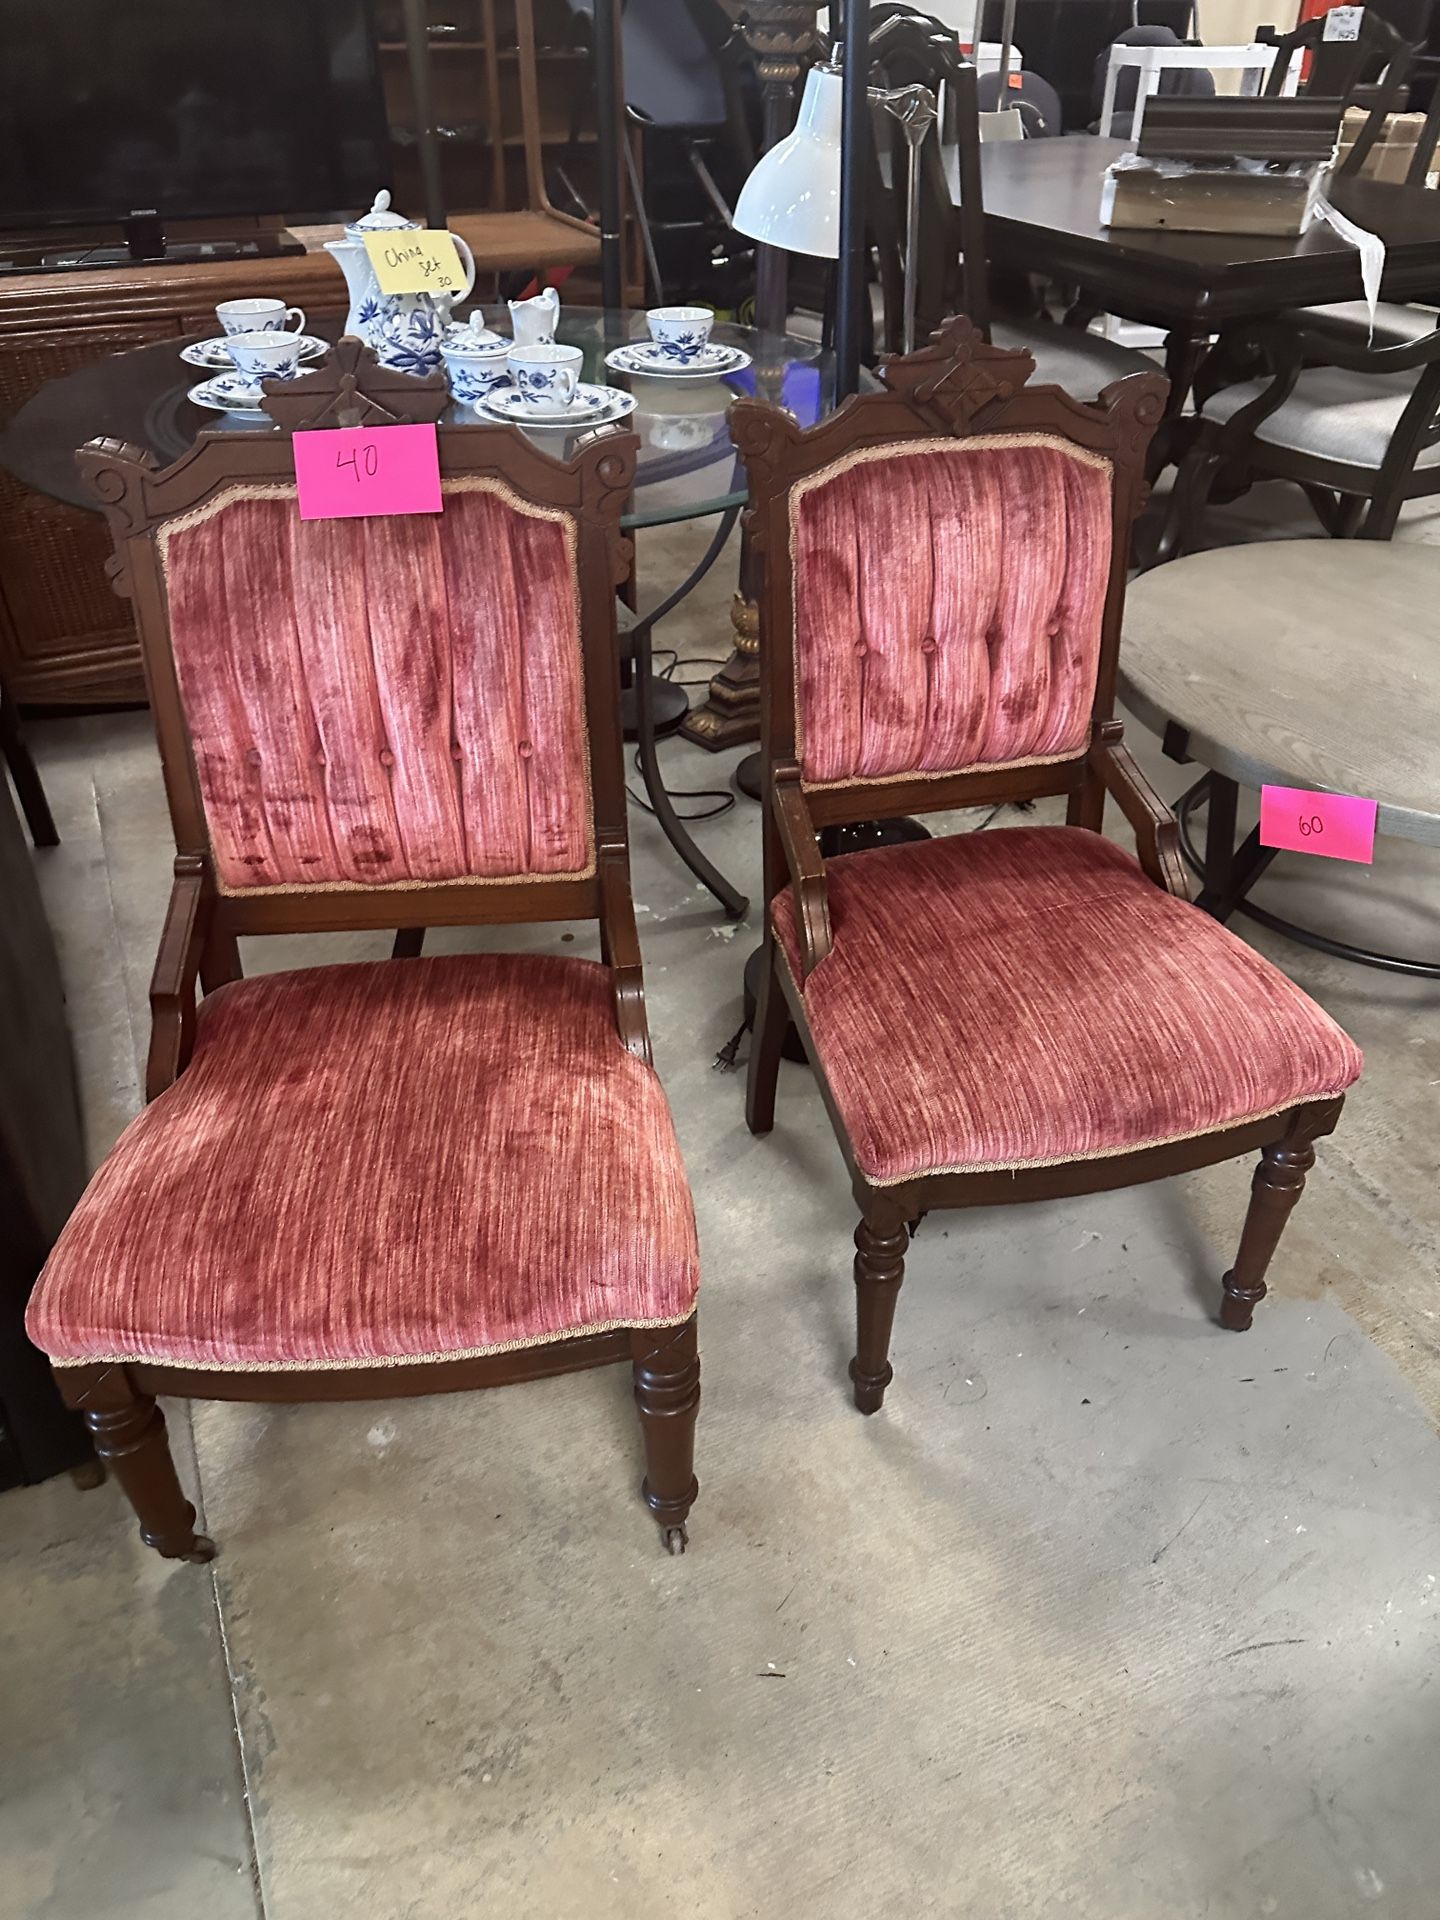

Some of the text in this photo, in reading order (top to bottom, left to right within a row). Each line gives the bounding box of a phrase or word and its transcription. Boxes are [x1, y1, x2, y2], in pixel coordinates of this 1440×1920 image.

[384, 246, 424, 268] China
[437, 276, 453, 288] 30
[336, 444, 378, 482] 40
[1299, 815, 1324, 836] 60
